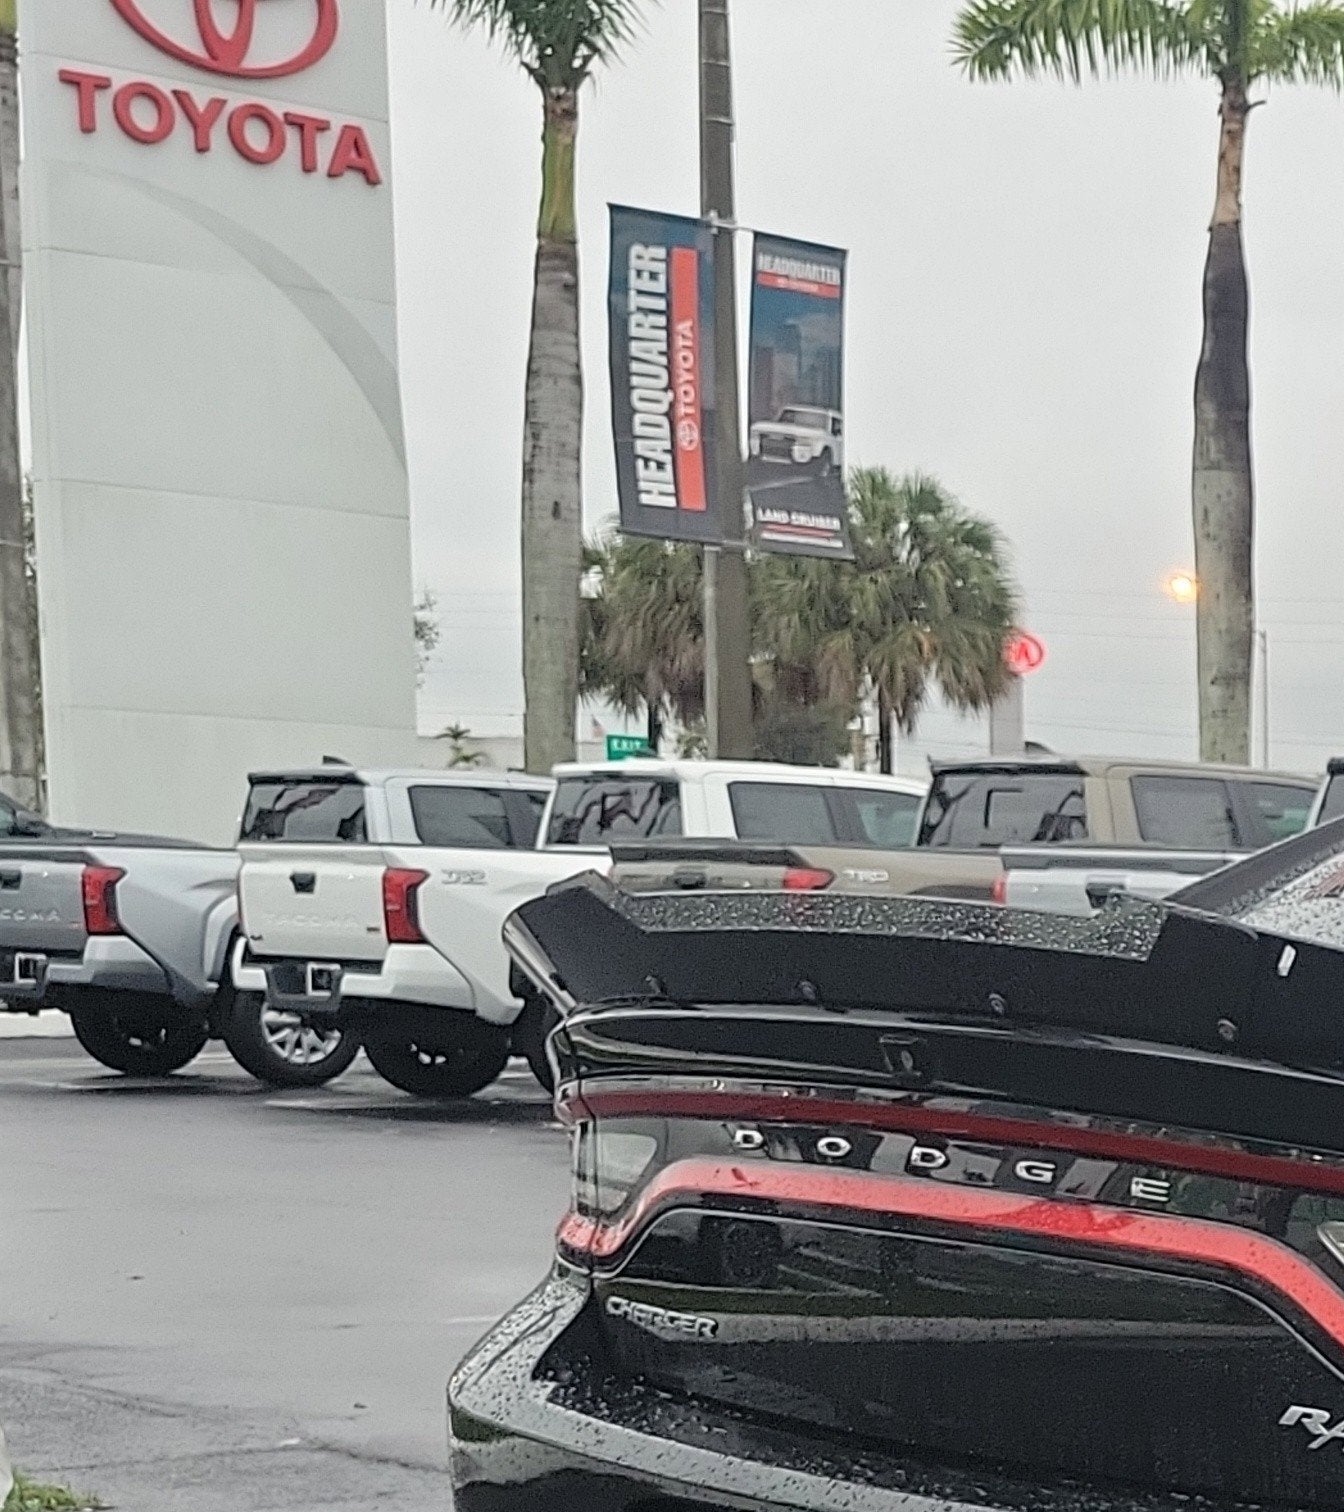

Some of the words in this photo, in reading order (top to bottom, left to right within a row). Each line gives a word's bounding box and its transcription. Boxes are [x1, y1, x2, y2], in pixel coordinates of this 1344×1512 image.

[58, 69, 382, 186] TOYOTA
[628, 243, 676, 507] HEADQUARTER
[675, 319, 696, 416] TOYOTA
[757, 506, 789, 524] LAND
[733, 1129, 1171, 1202] DODGE
[606, 1295, 718, 1338] CHARGER
